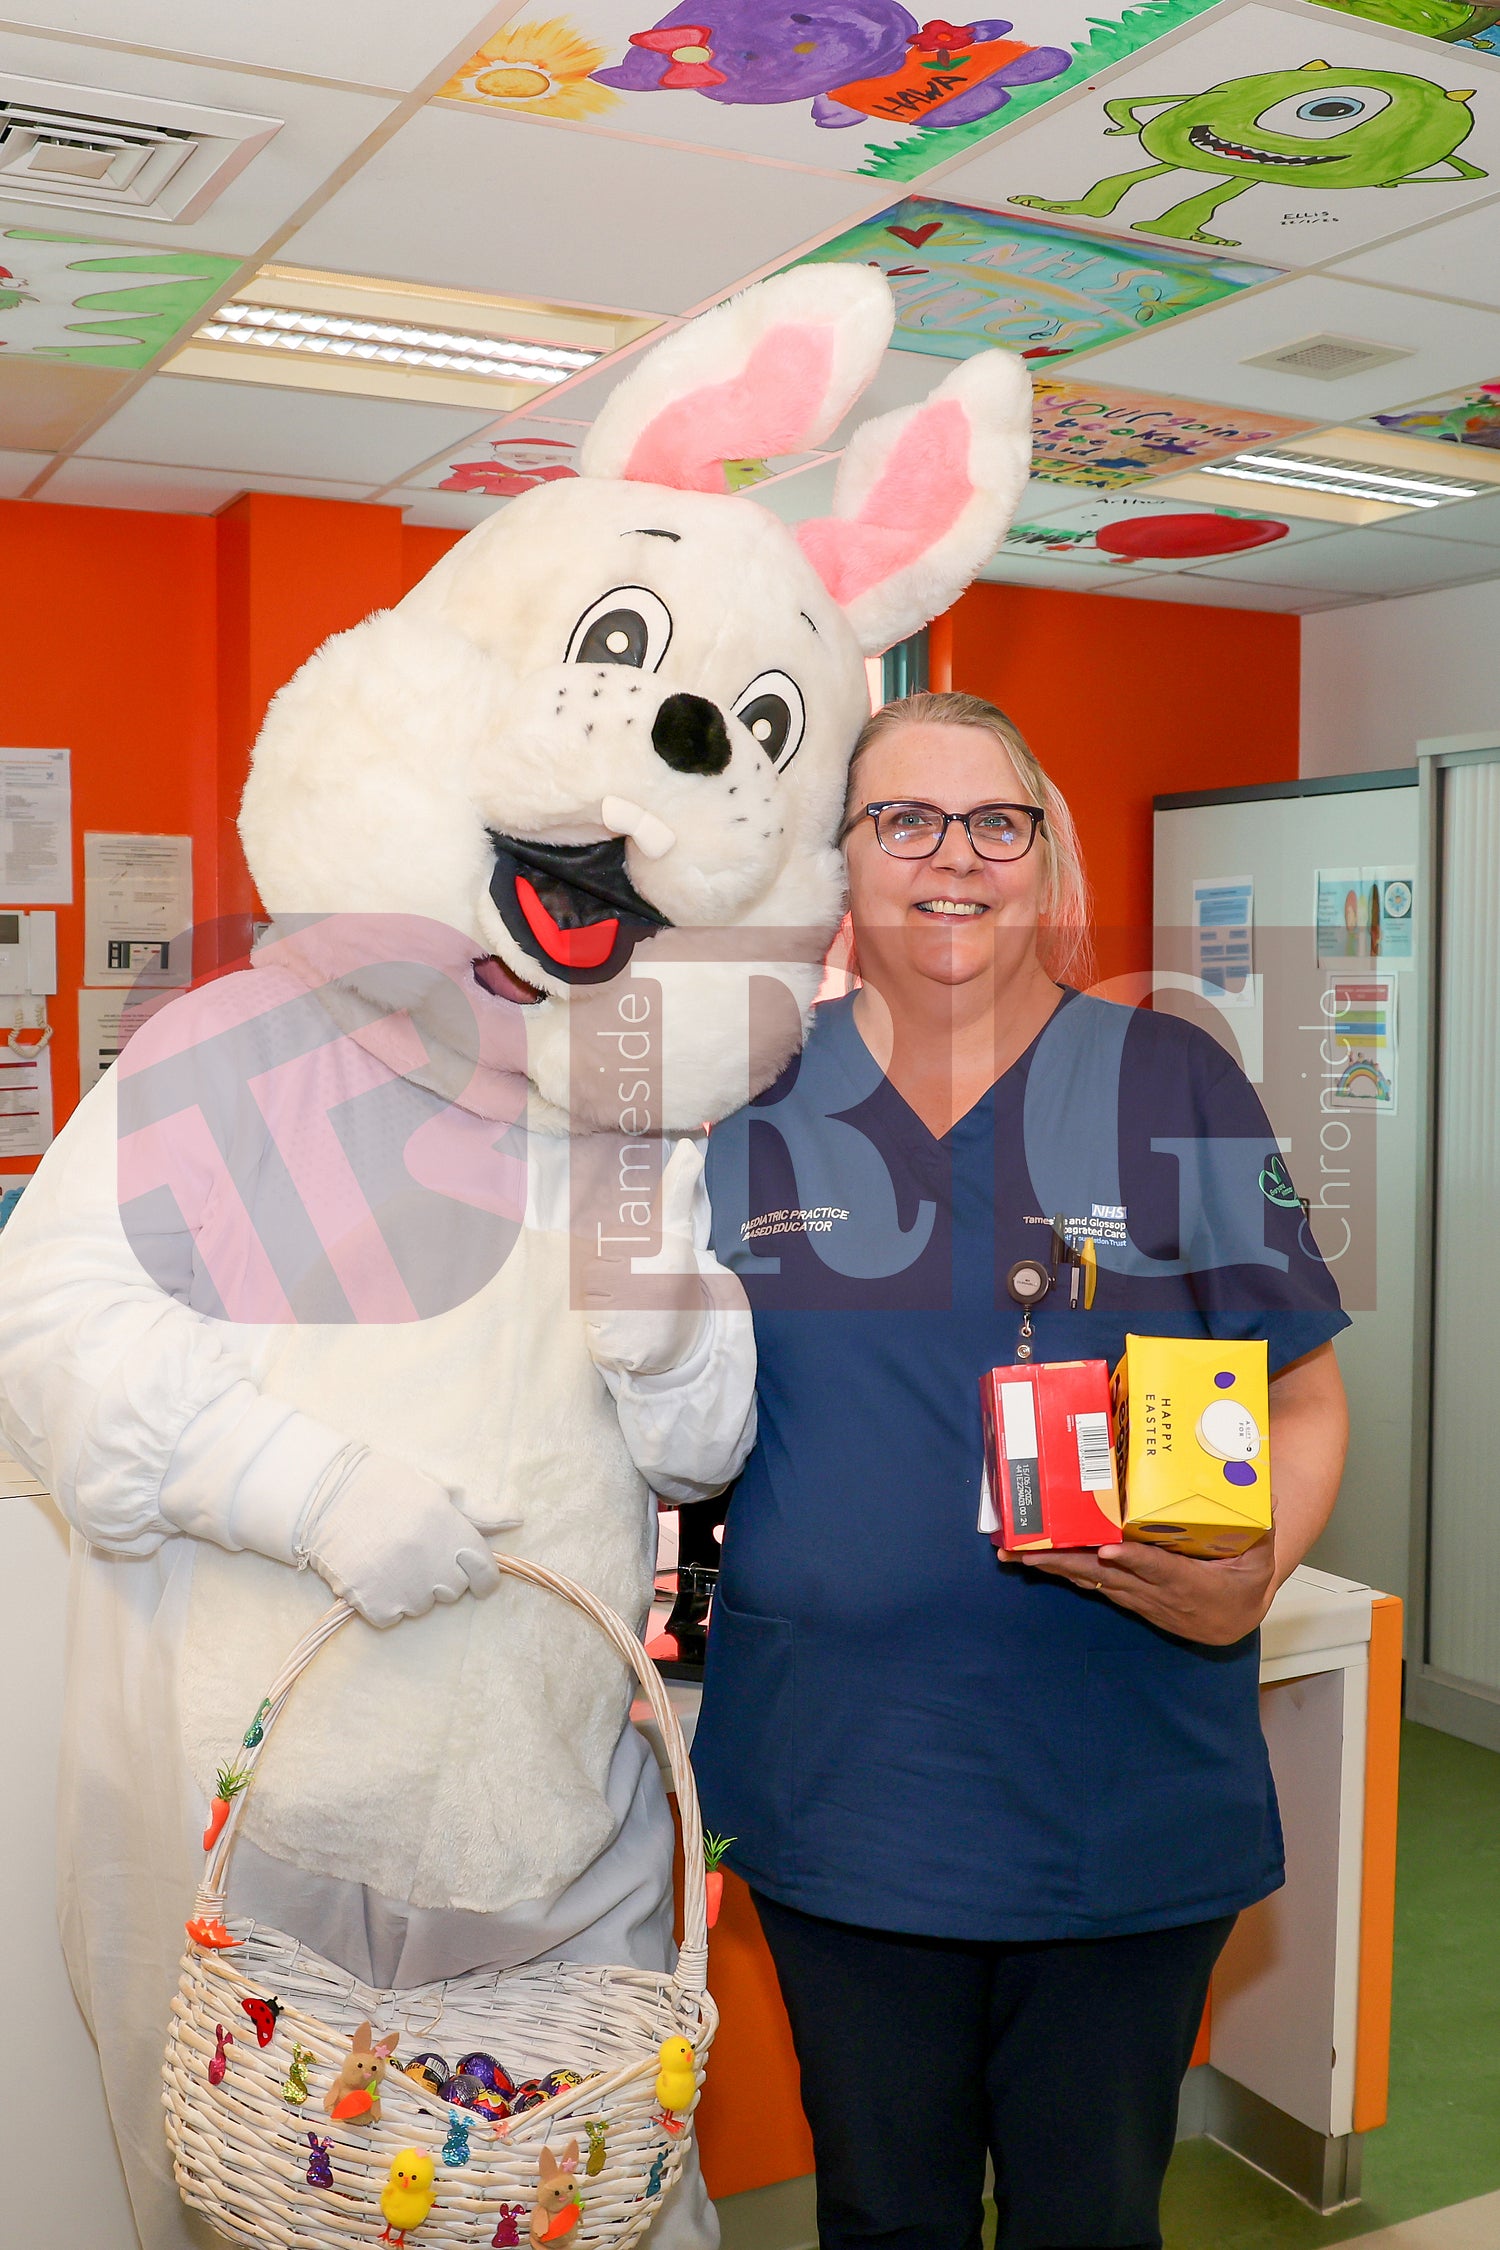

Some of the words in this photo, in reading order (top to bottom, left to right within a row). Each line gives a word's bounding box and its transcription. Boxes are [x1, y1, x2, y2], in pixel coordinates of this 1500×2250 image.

[871, 76, 968, 116] HAWA
[962, 243, 1166, 294] NHS
[740, 1209, 790, 1235] PAEDIATRIC
[789, 1206, 850, 1221] PRACTICE
[1023, 1216, 1067, 1226] Tames
[1069, 1217, 1087, 1226] and
[1089, 1218, 1127, 1231] Glossop
[1092, 1204, 1126, 1218] NHS
[772, 1220, 833, 1234] EDUCATOR
[1064, 1226, 1103, 1237] egrated
[1104, 1229, 1127, 1239] Care
[1110, 1239, 1127, 1247] Trust
[1146, 1394, 1157, 1456] EASTER
[1161, 1398, 1172, 1452] HAPPY
[1022, 1464, 1033, 1506] 15/06/2025
